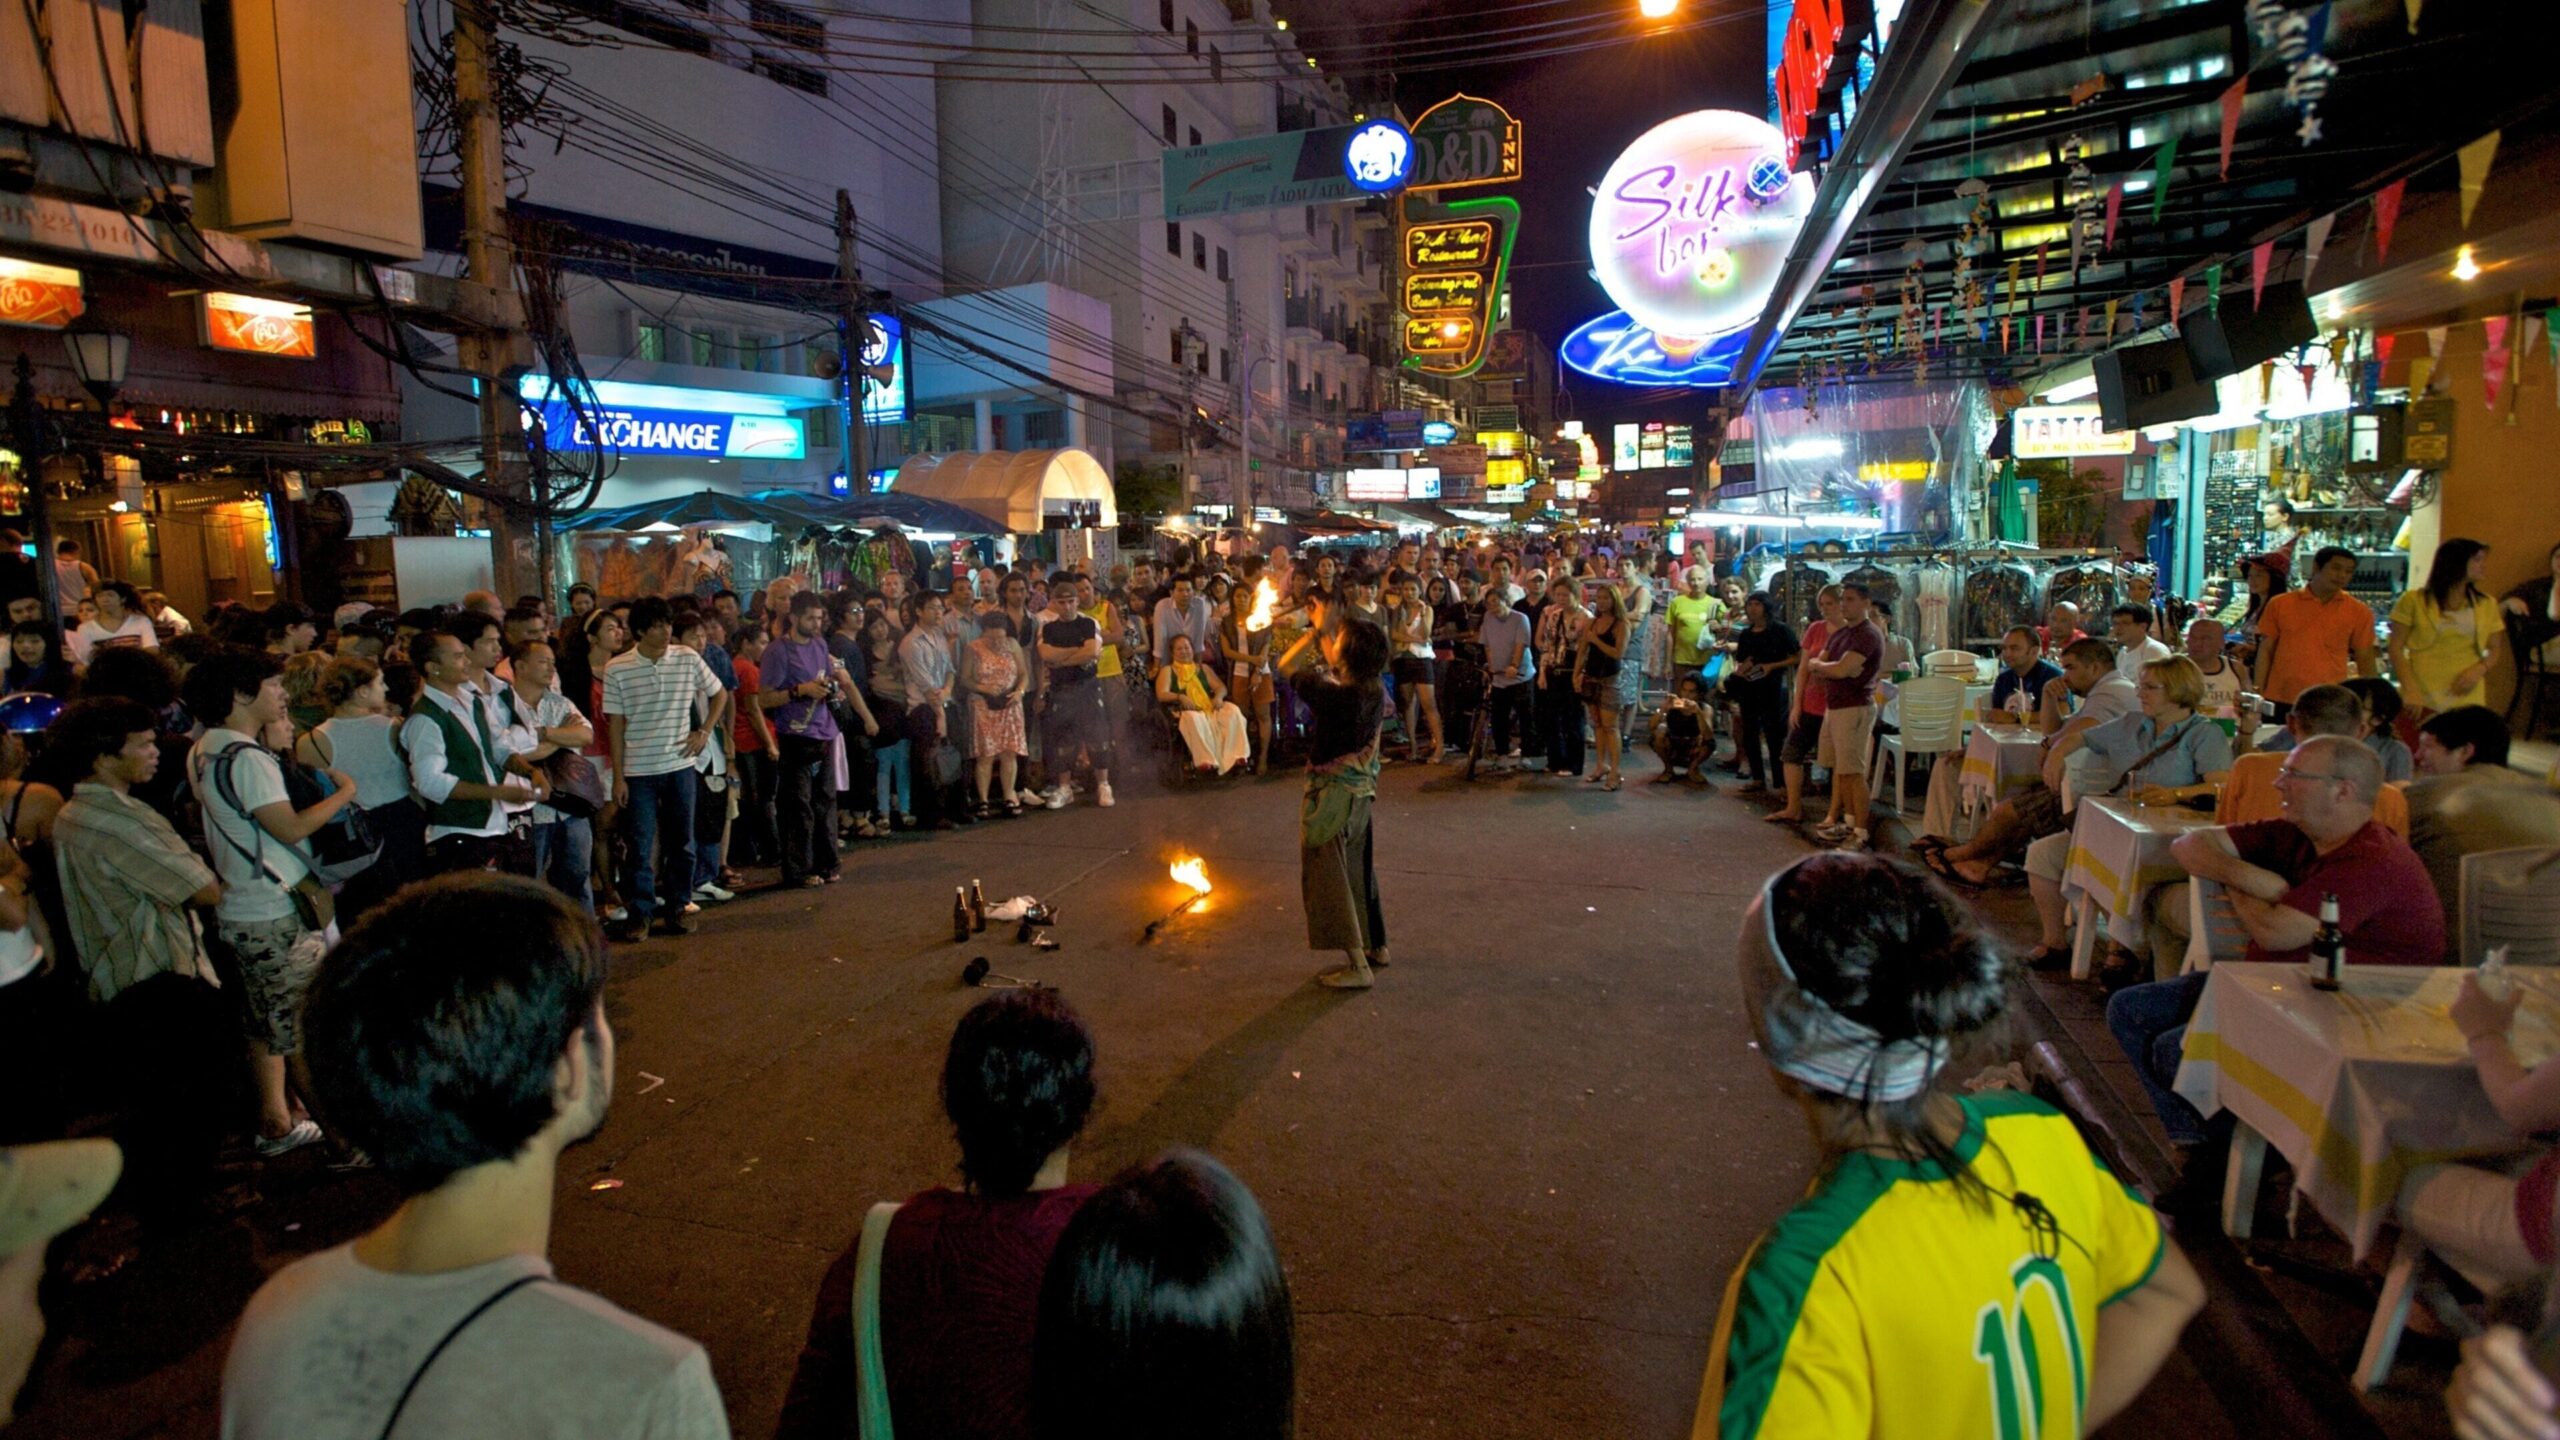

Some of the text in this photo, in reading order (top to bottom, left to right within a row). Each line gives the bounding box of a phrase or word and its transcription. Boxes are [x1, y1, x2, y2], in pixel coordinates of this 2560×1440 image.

[1413, 129, 1498, 185] D&D
[1502, 125, 1516, 173] INN
[1614, 164, 1737, 241] Silk
[572, 418, 721, 451] EXCHANGE
[2022, 416, 2127, 441] TATTO
[1973, 1252, 2084, 1440] 10
